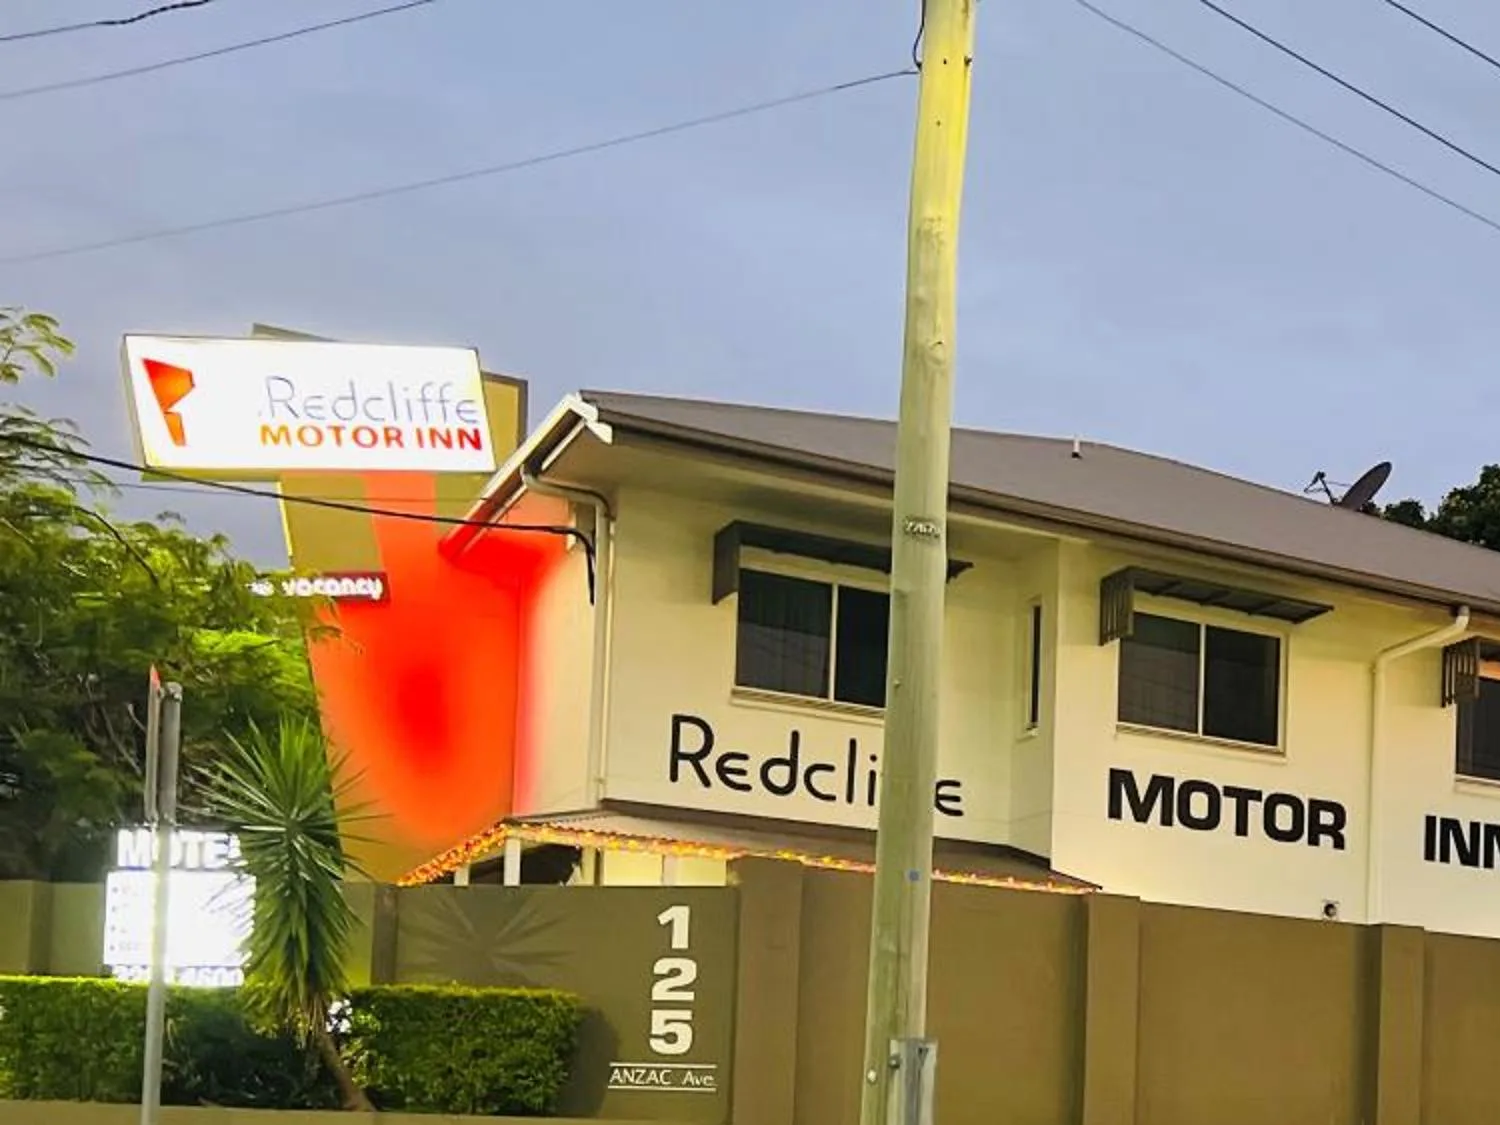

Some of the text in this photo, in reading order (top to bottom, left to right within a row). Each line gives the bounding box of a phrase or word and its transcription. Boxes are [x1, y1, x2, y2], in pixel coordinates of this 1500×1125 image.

[266, 375, 480, 424] Redcliffe
[260, 424, 483, 451] MOTOR INN
[669, 713, 964, 817] Redclie
[1107, 767, 1348, 851] MOTOR
[649, 905, 698, 1055] 125
[609, 1067, 672, 1085] ANZAC
